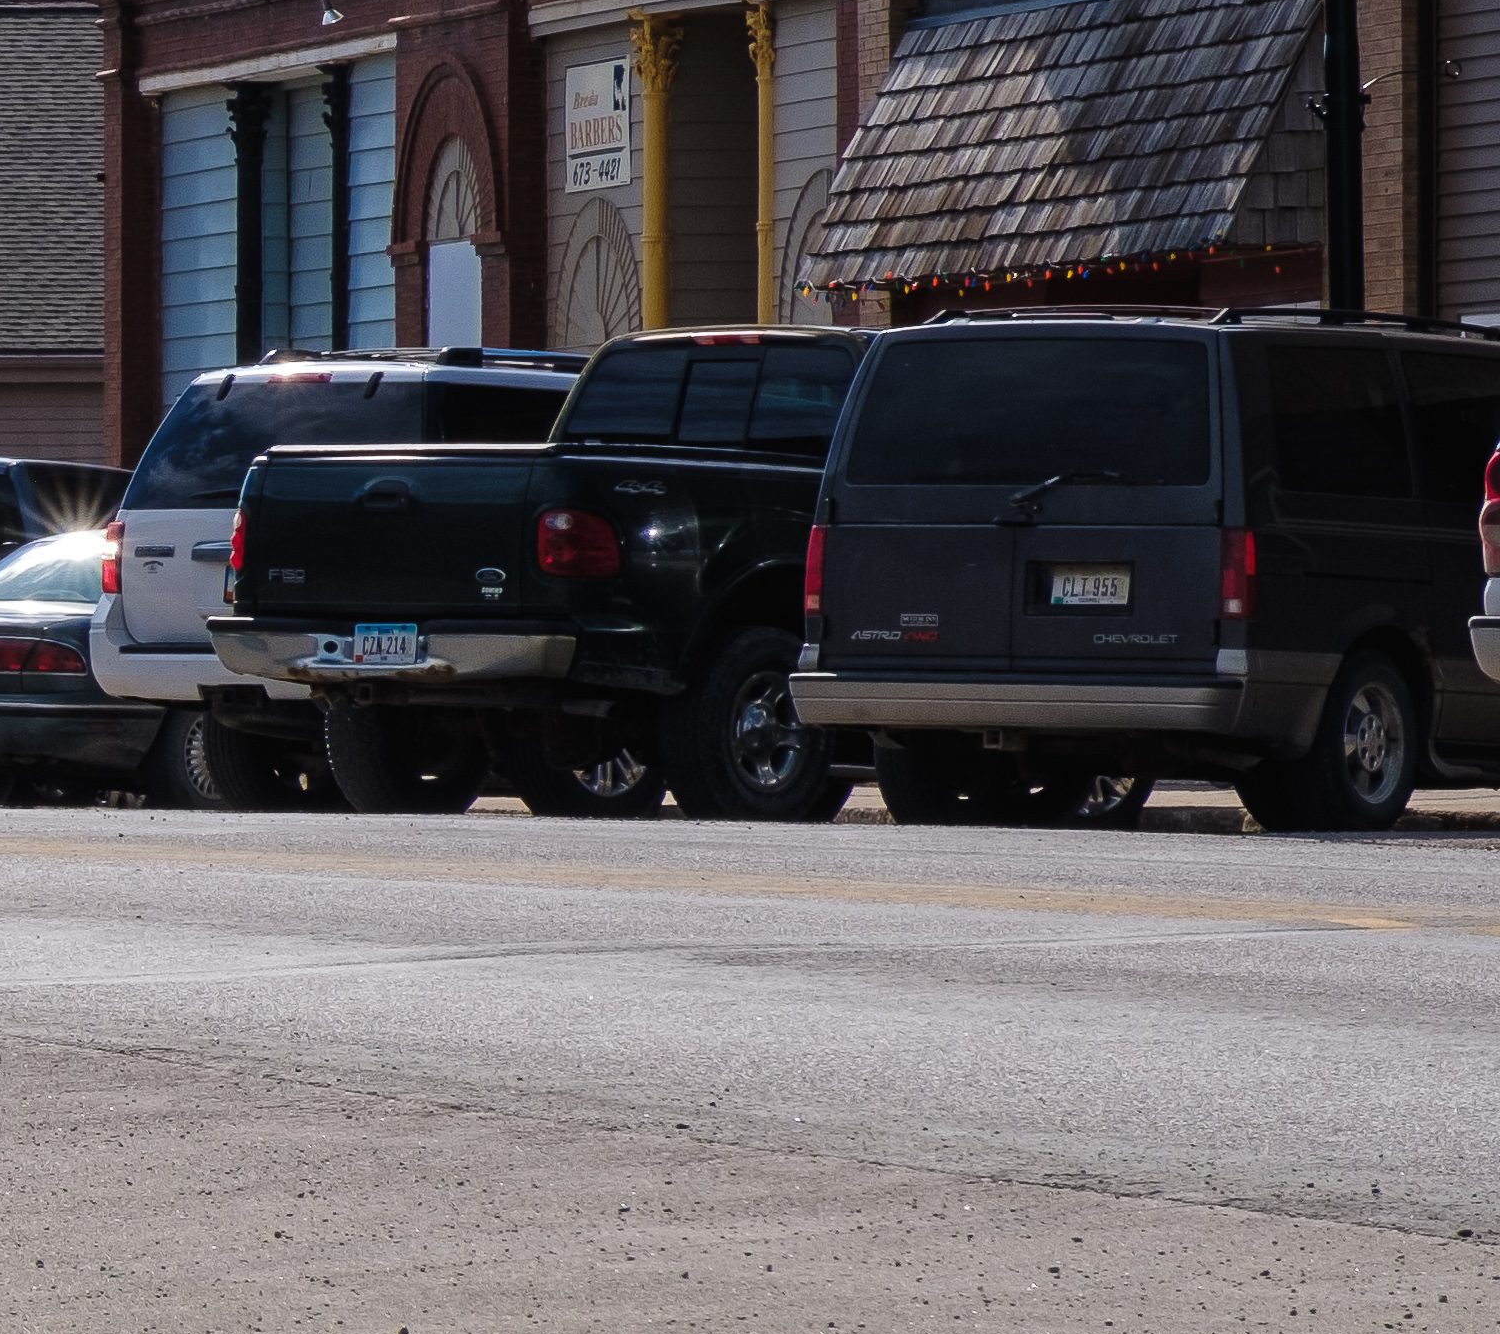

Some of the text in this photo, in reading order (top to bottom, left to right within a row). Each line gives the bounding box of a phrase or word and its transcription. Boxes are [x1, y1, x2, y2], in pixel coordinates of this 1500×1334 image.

[573, 90, 598, 110] Breda
[570, 115, 623, 149] BARBERS
[1062, 576, 1119, 597] CLT 955
[851, 630, 902, 640] ASTRO
[1093, 634, 1178, 644] CHEVROLET
[363, 636, 406, 655] CZN 214
